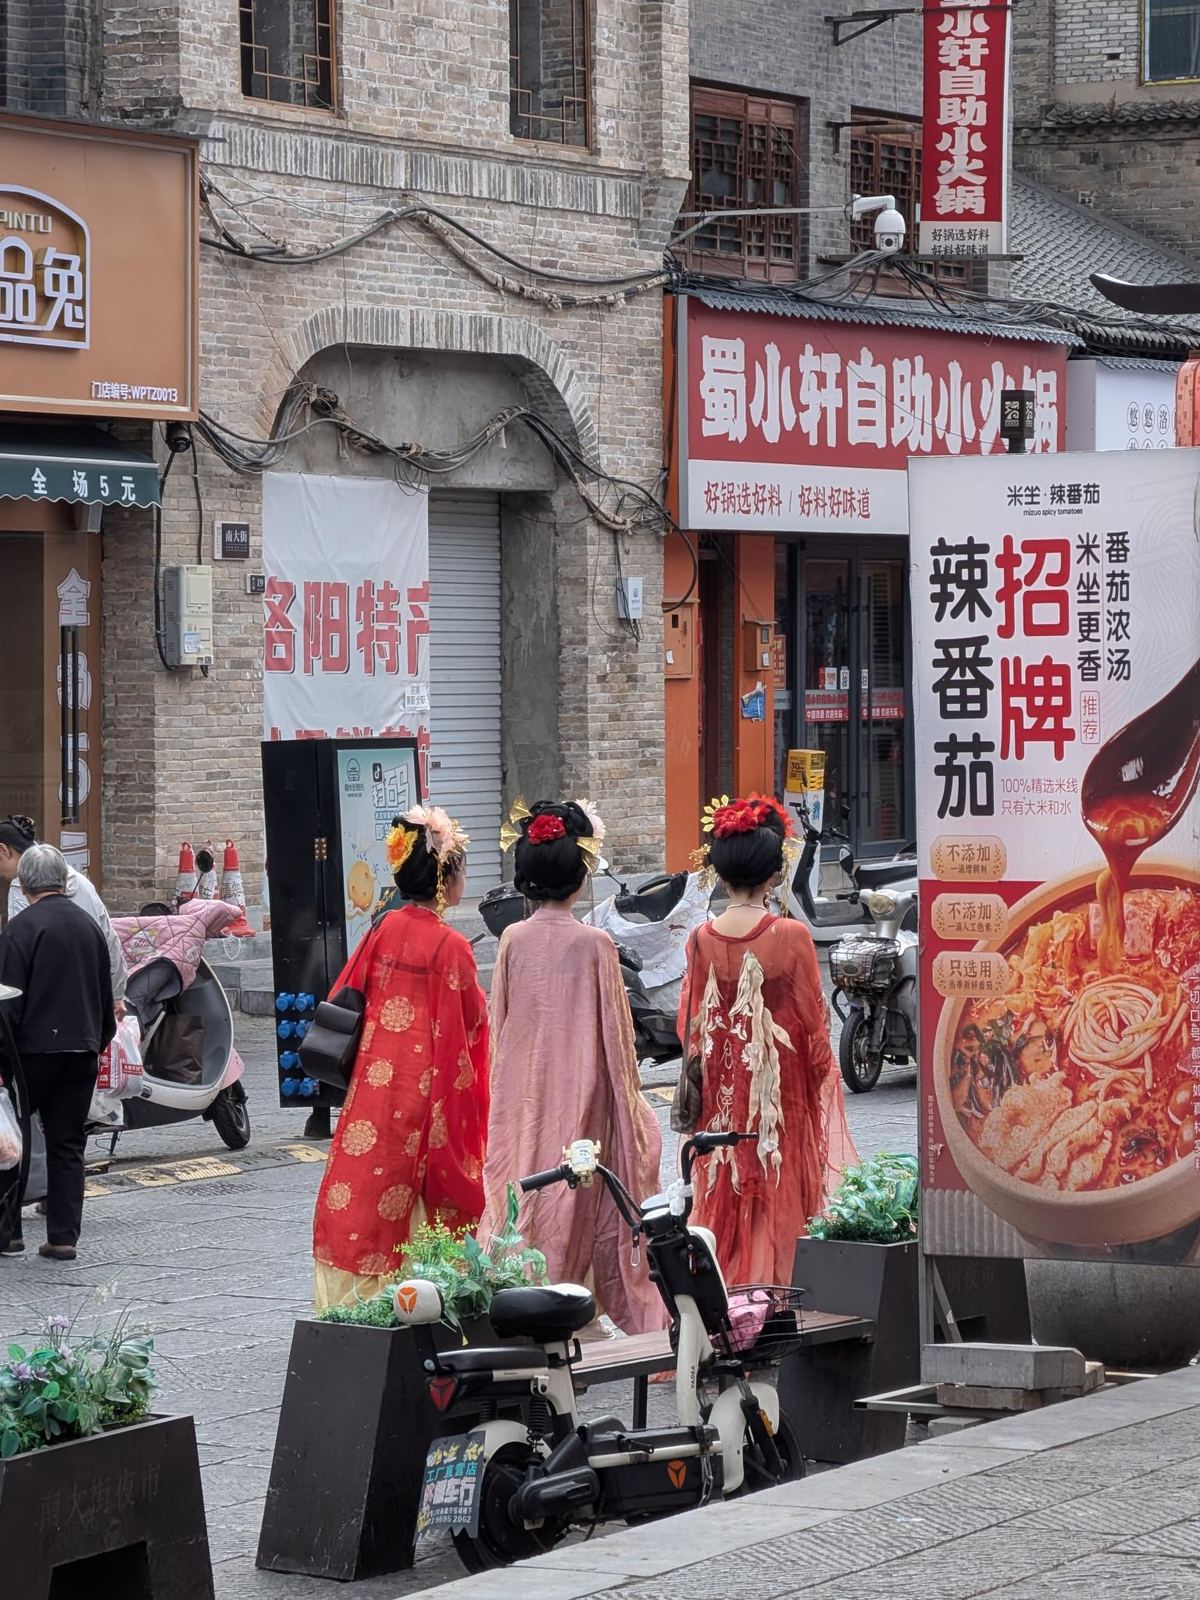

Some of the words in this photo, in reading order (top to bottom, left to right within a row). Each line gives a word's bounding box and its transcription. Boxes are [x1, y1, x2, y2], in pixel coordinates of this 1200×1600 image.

[932, 0, 991, 215] 小轩自助小火锅
[931, 228, 990, 242] 好锅选好料
[704, 480, 783, 517] 好锅选好料
[798, 484, 872, 519] 好料好味道
[1042, 508, 1056, 518] spicy
[1057, 507, 1084, 515] tomatoes
[225, 530, 248, 543] 南大街
[1076, 532, 1101, 682] 米坐更香
[1105, 531, 1131, 682] 番茄浓汤
[995, 534, 1076, 761] 招牌
[929, 536, 996, 819] 辣番茄
[1082, 695, 1099, 740] 推荐
[1000, 776, 1078, 795] 100%精选米线
[1001, 799, 1072, 816] 只有大米和水
[947, 844, 991, 862] 不添加
[947, 901, 992, 920] 不添加
[949, 959, 992, 979] 只选用
[426, 1461, 478, 1484] 工厂直营店
